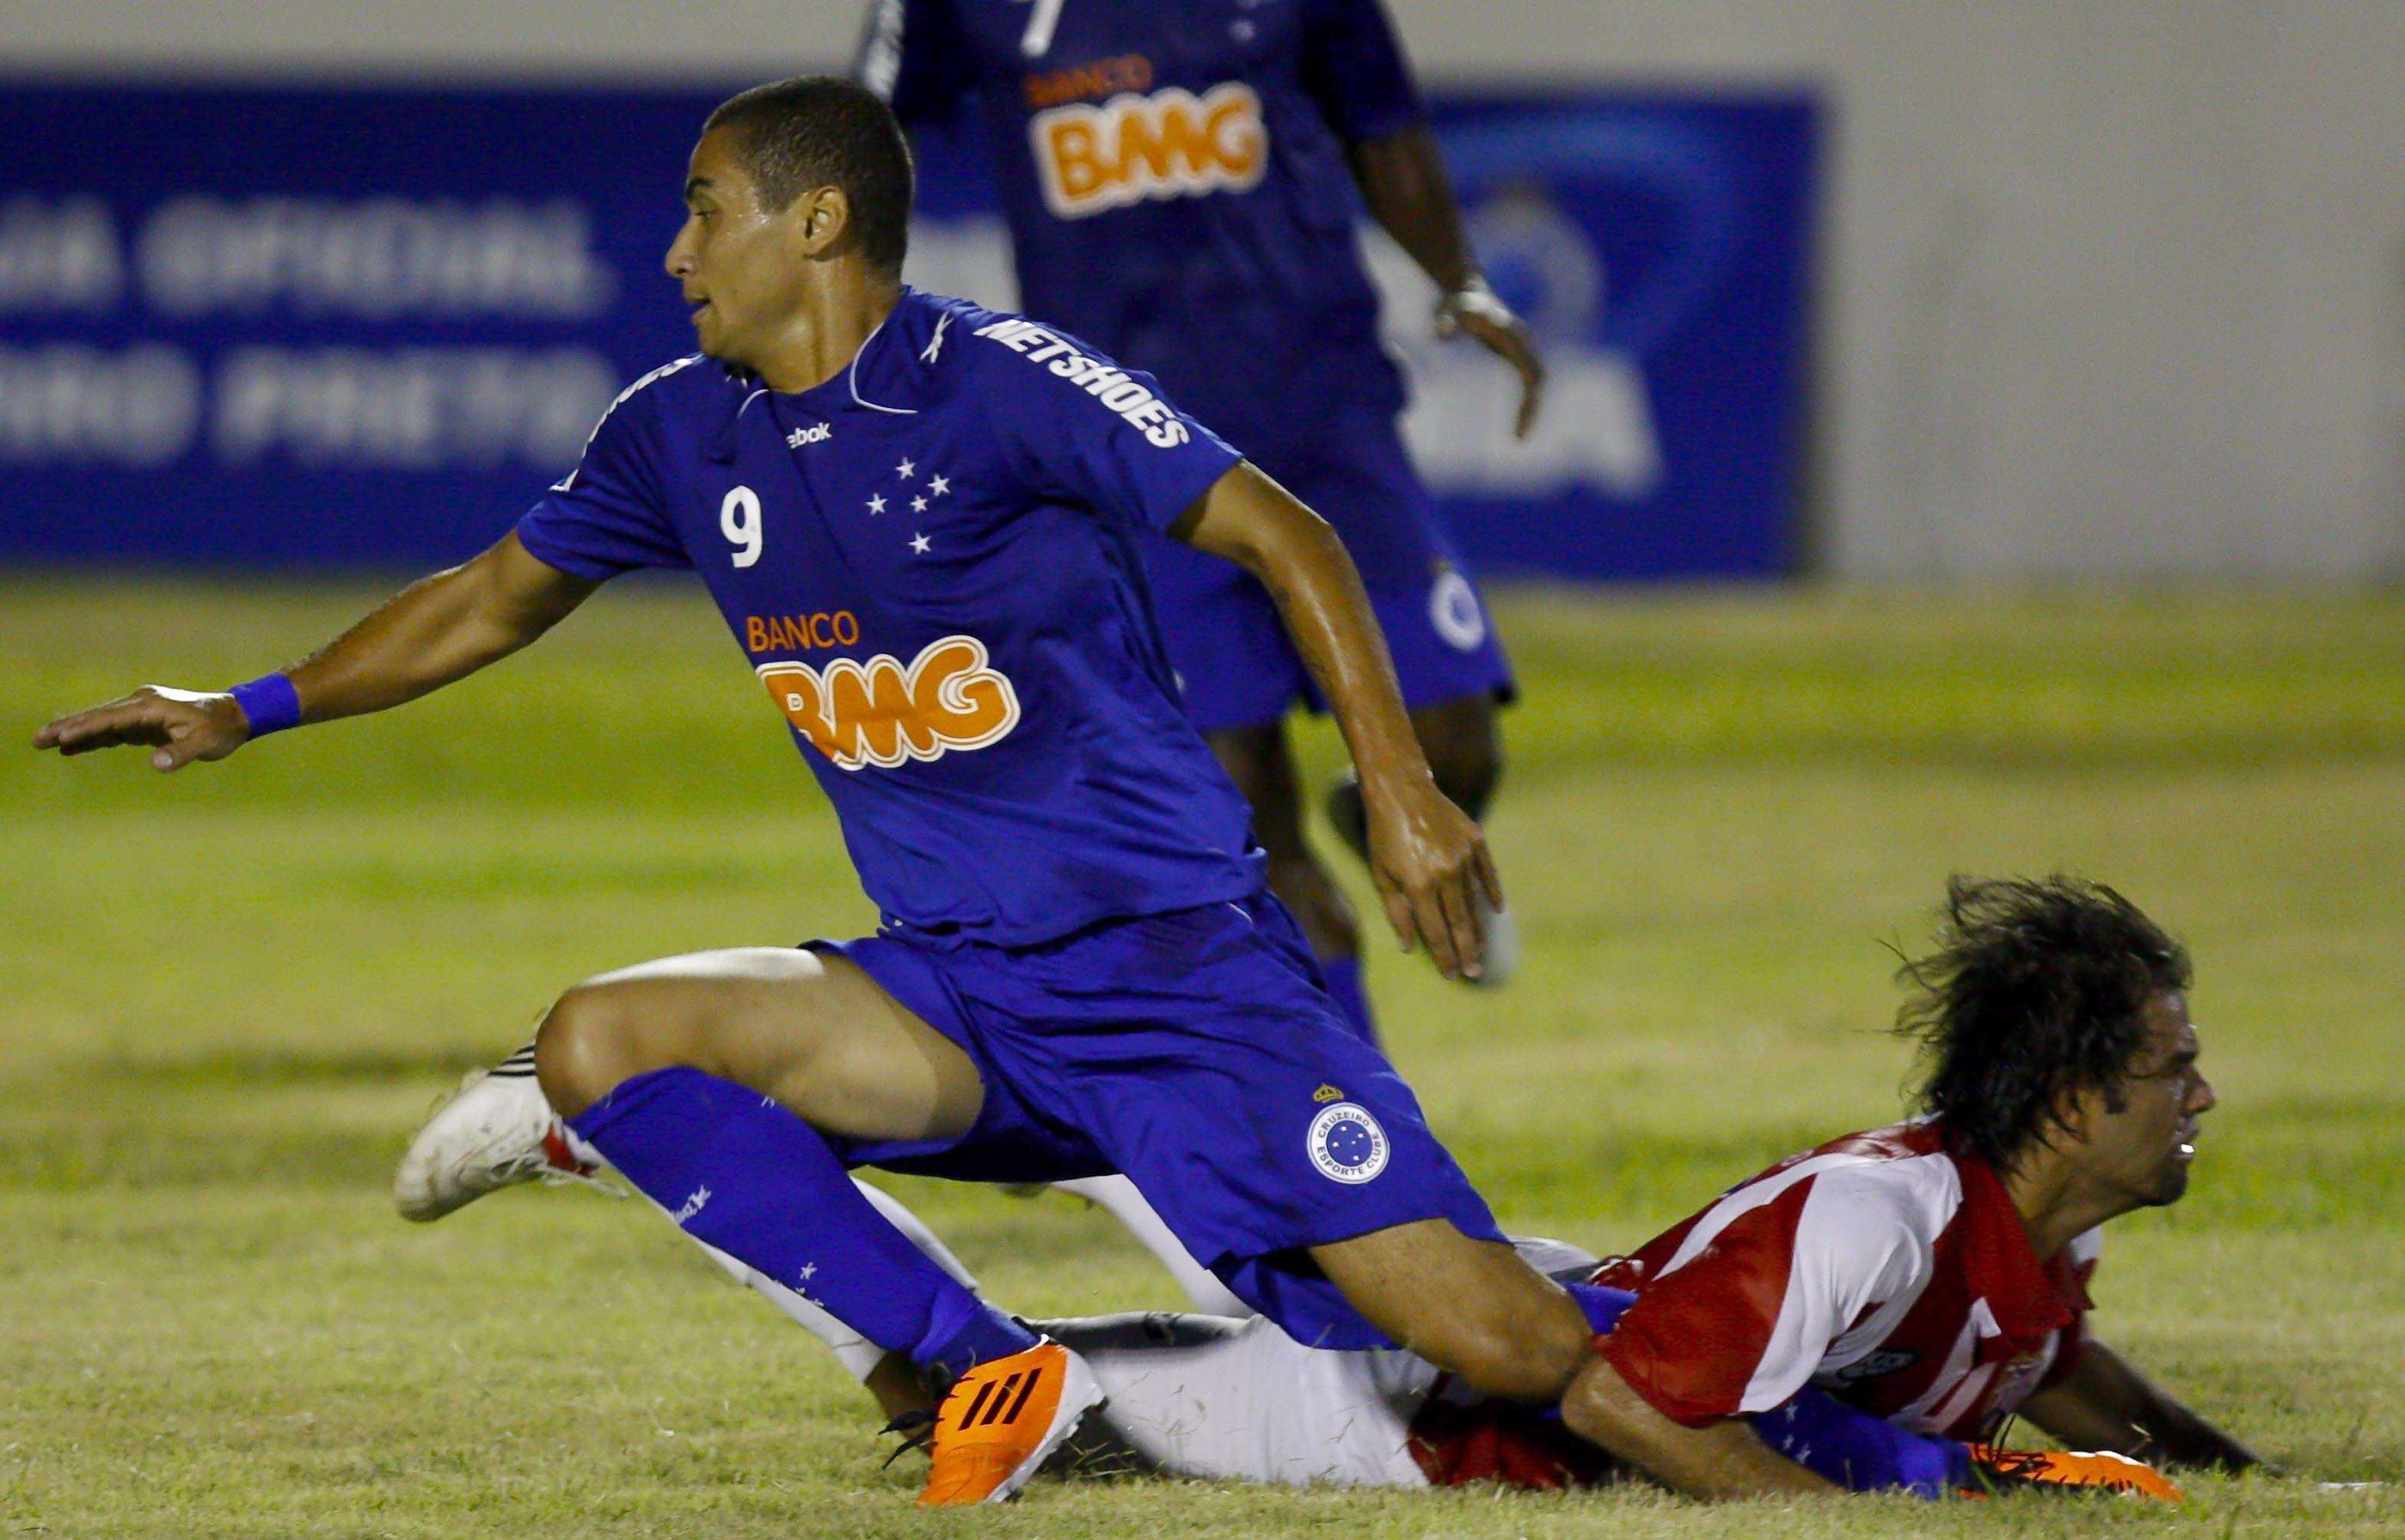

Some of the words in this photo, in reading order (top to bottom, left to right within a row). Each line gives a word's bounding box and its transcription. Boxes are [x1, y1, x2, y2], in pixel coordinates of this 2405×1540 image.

[1029, 81, 1269, 220] BMG
[973, 319, 1190, 448] NETSHOES
[719, 485, 763, 568] 9
[746, 610, 859, 652] BANCO
[1318, 1111, 1370, 1139] CRUZEIRO
[1318, 1146, 1365, 1176] ESPORTE
[1367, 1133, 1382, 1169] CLUBE
